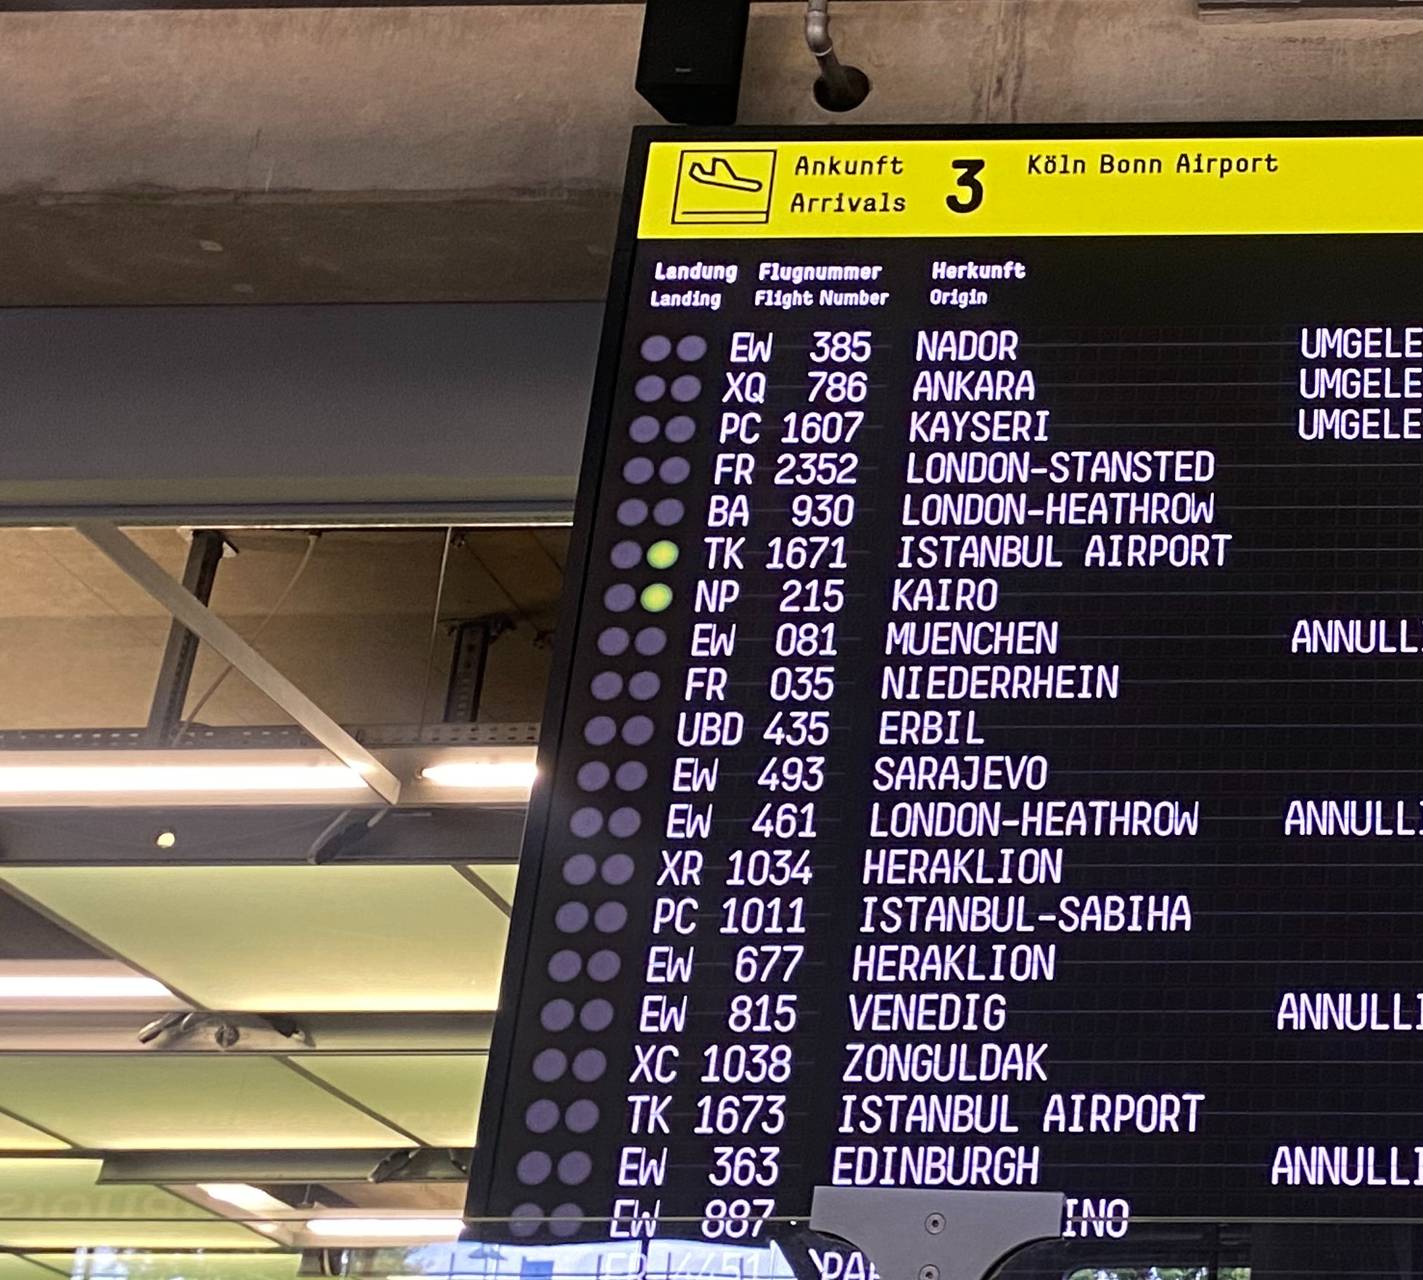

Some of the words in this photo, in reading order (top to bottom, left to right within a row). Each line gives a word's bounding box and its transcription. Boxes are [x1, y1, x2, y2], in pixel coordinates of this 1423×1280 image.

[794, 155, 904, 176] Ankunft
[1028, 154, 1086, 175] Köln
[1100, 154, 1163, 174] Bonn
[1176, 153, 1279, 179] Airport
[790, 192, 906, 213] Arrivals
[945, 159, 986, 214] 3
[654, 261, 738, 284] Landung
[758, 262, 883, 285] Flugnummer
[931, 260, 1026, 280] Herkunft
[650, 290, 722, 310] Landing
[754, 289, 814, 310] Flight
[818, 289, 890, 307] Number
[929, 288, 988, 309] Origin
[729, 331, 774, 363] EW
[809, 330, 872, 363] 385
[915, 329, 1019, 362] NADOR
[721, 371, 767, 404] XQ
[807, 371, 868, 403] 786
[912, 369, 1035, 402] ANKARA
[719, 411, 762, 445] PC
[780, 410, 865, 444] 1607
[909, 410, 1050, 443] KAYSERI
[714, 453, 755, 485] FR
[773, 452, 859, 485] 2352
[906, 450, 1215, 485] LONDON-STANSTED
[707, 494, 750, 527] BA
[791, 493, 855, 527] 930
[902, 492, 1215, 526] LONDON-HEATHROW
[703, 536, 746, 570] TK
[765, 536, 847, 570] 1671
[897, 534, 1063, 569] ISTANBUL
[1084, 533, 1233, 568] AIRPORT
[694, 579, 740, 613] NP
[779, 578, 845, 613] 215
[891, 578, 998, 612] KAIRO
[690, 623, 737, 657] EW
[775, 622, 838, 657] 081
[885, 620, 1059, 656] MUENCHEN
[684, 667, 728, 701] FR
[770, 666, 835, 702] 035
[881, 664, 1119, 700] NIEDERRHEIN
[677, 711, 744, 747] UBD
[762, 710, 830, 746] 435
[878, 710, 985, 745] ERBIL
[672, 757, 719, 792] EW
[757, 756, 826, 792] 493
[872, 755, 1048, 792] SARAJEVO
[666, 803, 713, 839] EW
[751, 802, 817, 839] 461
[870, 800, 1199, 838] LONDON-HEATHROW
[656, 850, 704, 886] XR
[725, 849, 813, 886] 1034
[862, 847, 1063, 885] HERAKLION
[652, 897, 699, 935] PC
[719, 896, 806, 934] 1011
[859, 895, 1192, 934] ISTANBUL-SABIHA
[646, 945, 694, 983] EW
[735, 945, 805, 983] 677
[852, 943, 1056, 982] HERAKLION
[639, 994, 688, 1033] EW
[728, 994, 798, 1033] 815
[848, 993, 1007, 1032] VENEDIG
[628, 1044, 680, 1084] XC
[700, 1044, 792, 1084] 1038
[842, 1042, 1049, 1083] ZONGULDAK
[627, 1094, 673, 1134] TK
[693, 1094, 787, 1135] 1673
[838, 1094, 1019, 1134] ISTANBUL
[1042, 1093, 1206, 1133] AIRPORT
[618, 1146, 668, 1186] EW
[708, 1146, 780, 1187] 363
[831, 1145, 1040, 1186] EDINBURGH
